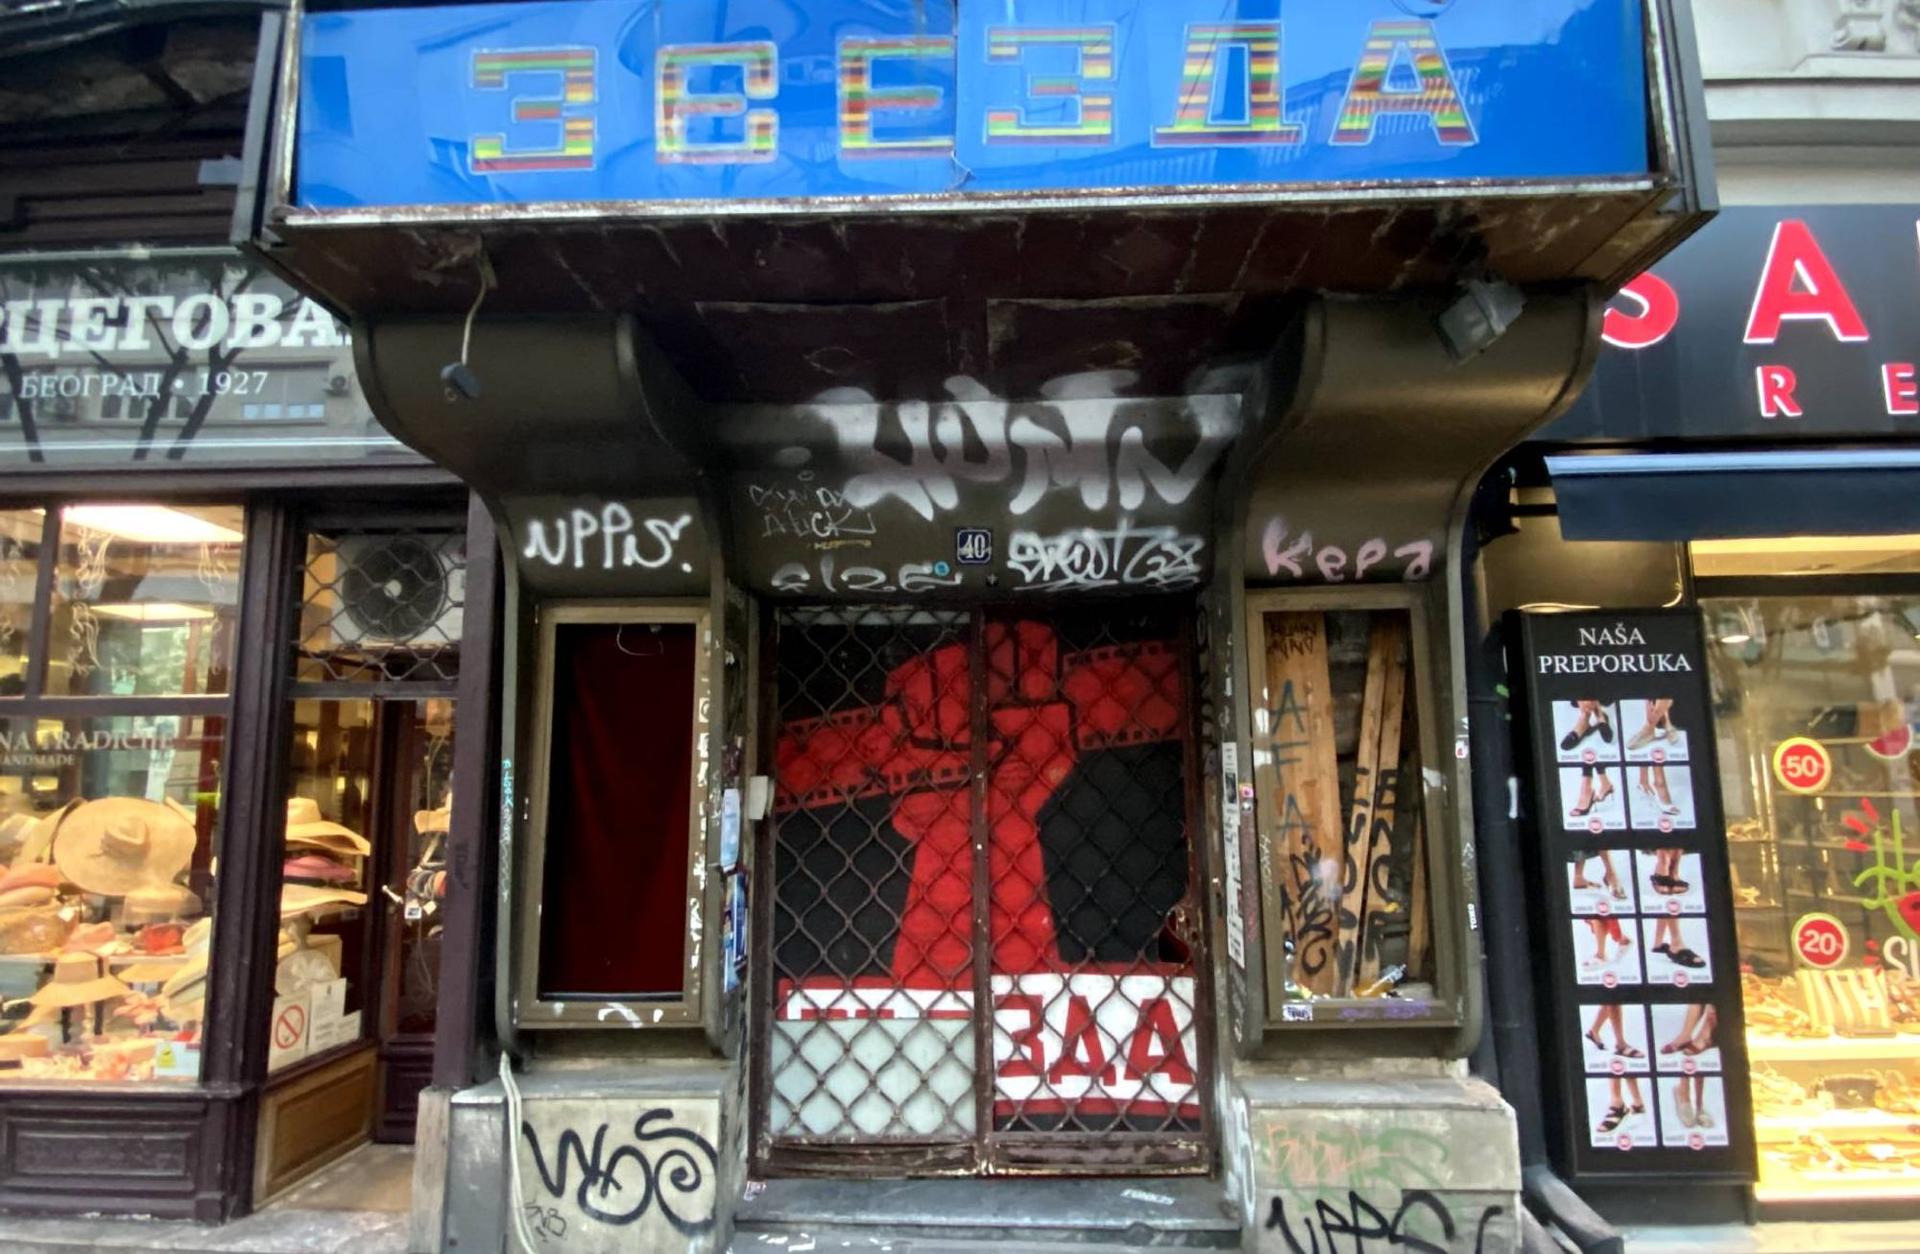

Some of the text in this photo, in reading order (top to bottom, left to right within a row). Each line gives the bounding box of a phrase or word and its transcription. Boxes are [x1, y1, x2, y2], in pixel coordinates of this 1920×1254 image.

[470, 19, 1479, 175] ЗВЕЗДА
[0, 293, 352, 358] ЦЕГОВА
[20, 371, 268, 399] БЕОГРАД 1927
[961, 534, 986, 560] 40
[1579, 622, 1647, 645] NAŠA
[1539, 653, 1692, 674] PREPORUKA
[1785, 754, 1819, 779] 50
[1802, 929, 1837, 956] 20
